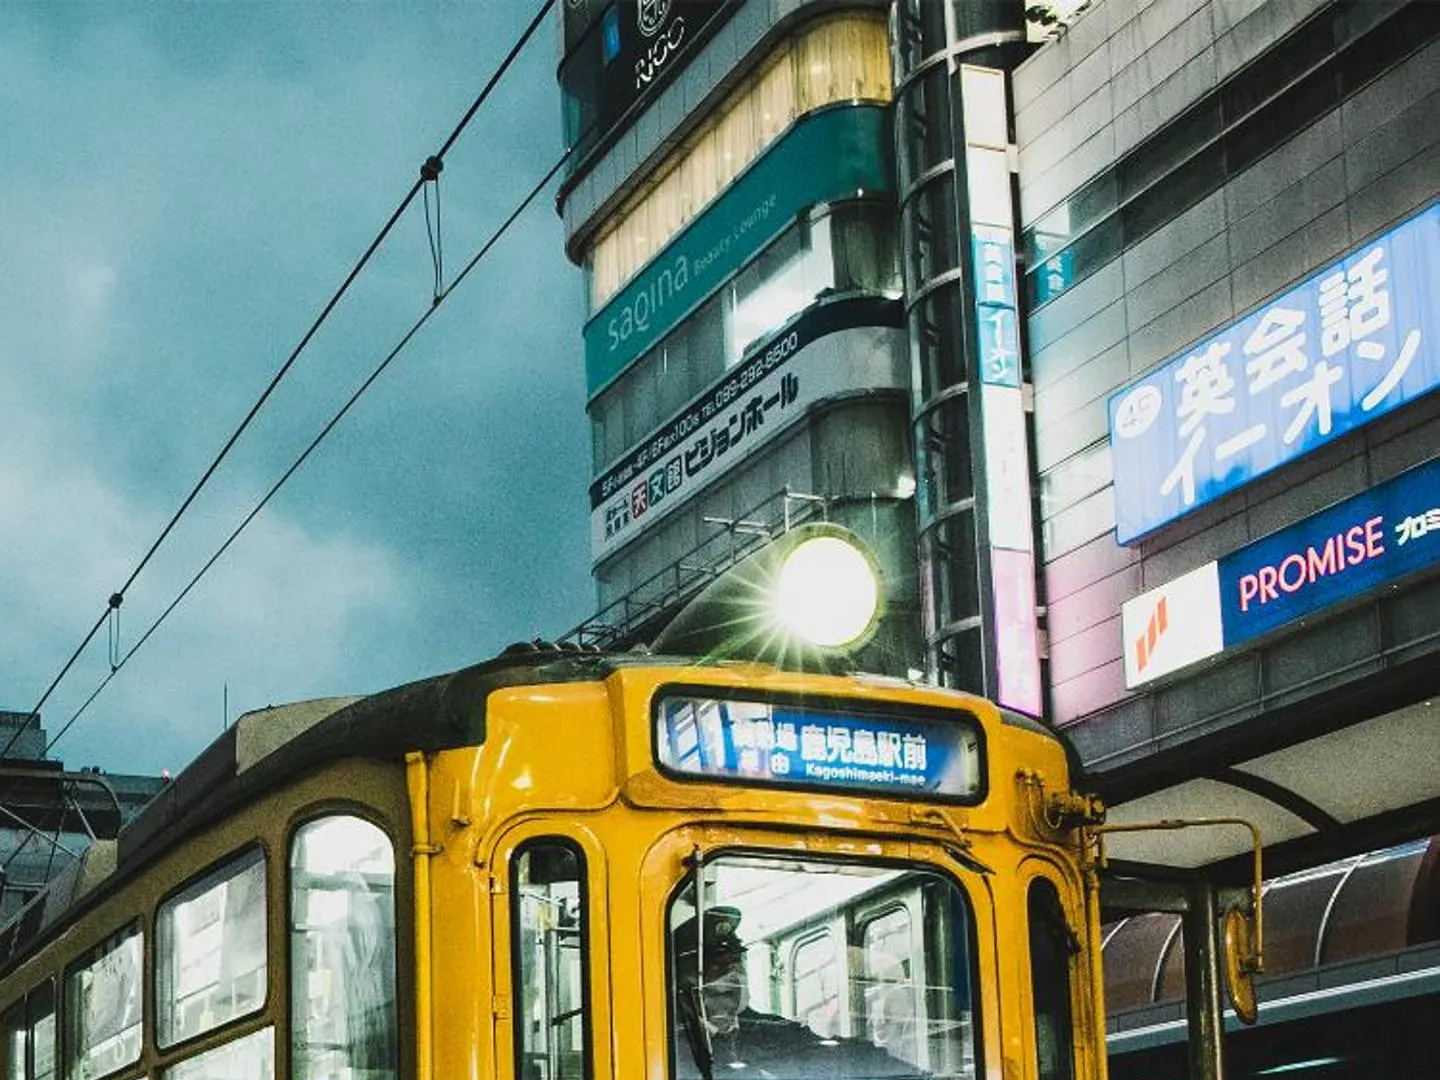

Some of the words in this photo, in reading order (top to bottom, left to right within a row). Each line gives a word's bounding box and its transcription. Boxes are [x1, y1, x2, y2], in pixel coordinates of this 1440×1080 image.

[1174, 246, 1391, 438] 英会話
[1160, 330, 1422, 506] イーオン
[1239, 516, 1385, 612] PROMISE
[801, 723, 927, 771] 鹿児島駅前
